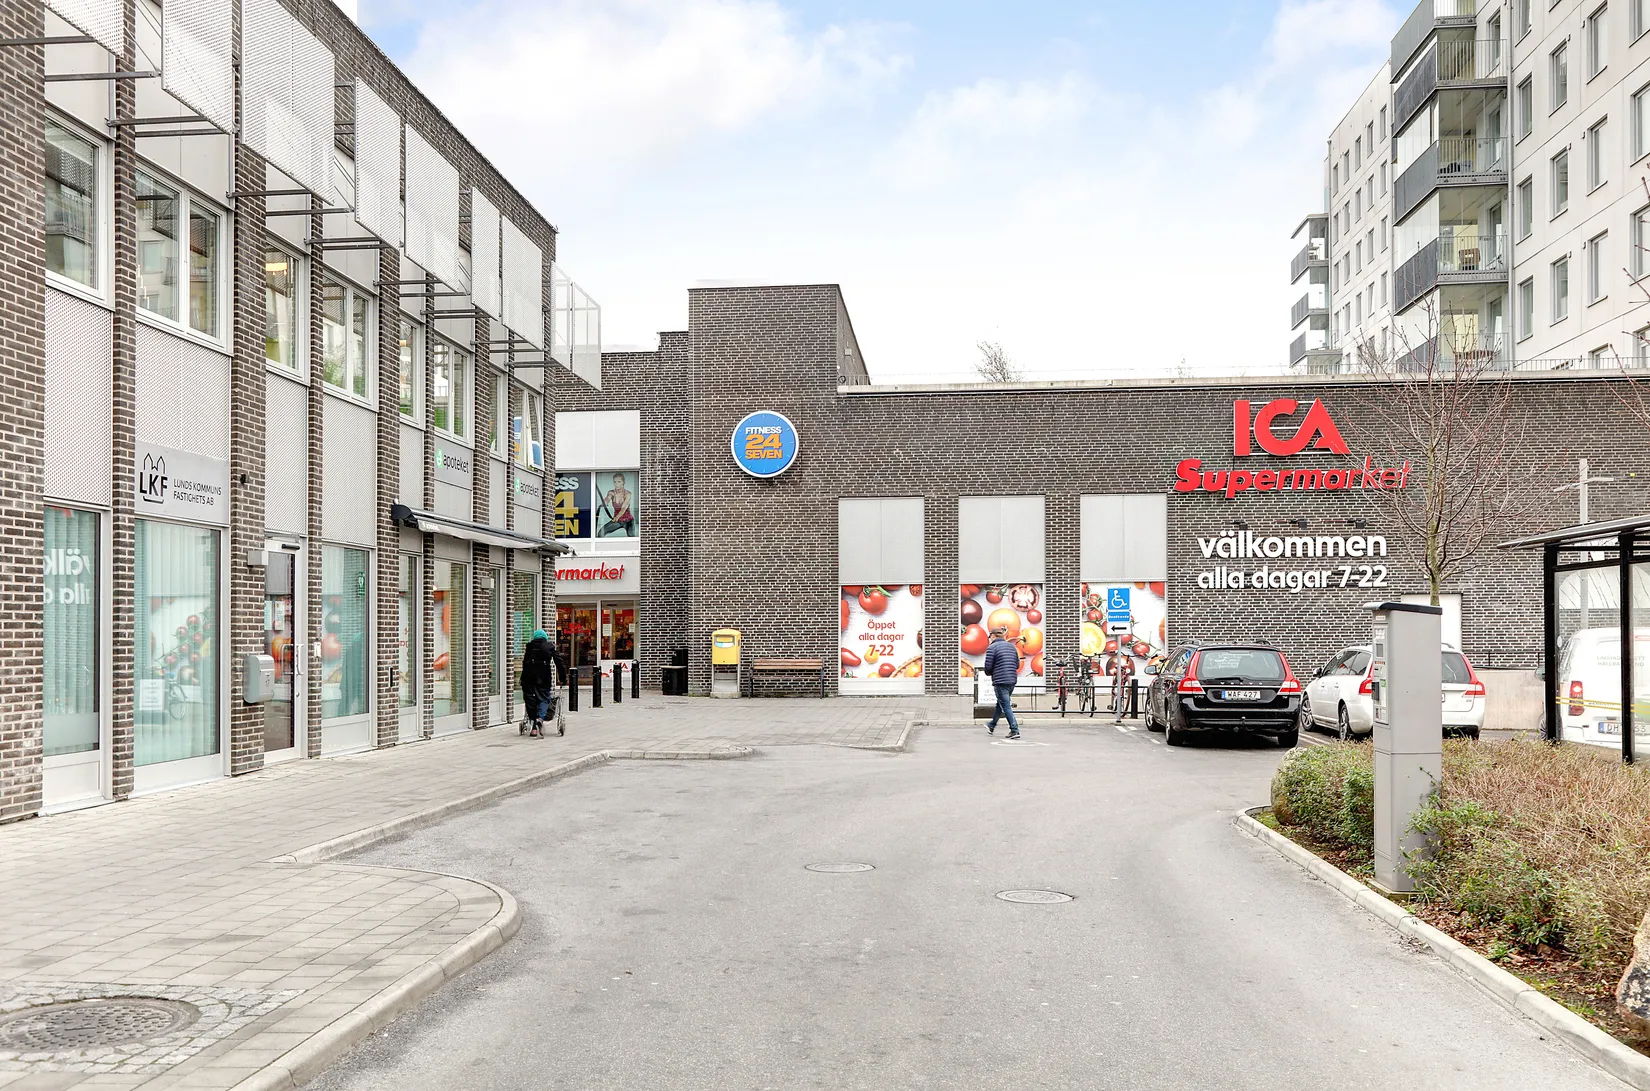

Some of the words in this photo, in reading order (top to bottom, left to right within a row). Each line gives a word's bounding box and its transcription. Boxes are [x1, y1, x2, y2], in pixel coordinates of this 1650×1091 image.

[745, 426, 782, 435] FITNESS
[1233, 397, 1351, 456] ICA
[745, 434, 782, 450] 24
[745, 449, 783, 460] SEVEN
[443, 454, 469, 474] apoteket
[139, 471, 168, 497] LKF
[1173, 455, 1412, 499] Supermarket
[173, 478, 193, 491] LUNDS
[193, 483, 222, 496] KOMMUNS
[173, 490, 206, 505] FASTIGHETS
[206, 496, 215, 506] AB
[1197, 530, 1387, 559] välkommen
[1197, 566, 1245, 589] alla
[1251, 565, 1332, 594] dagar
[1337, 564, 1388, 588] 7-22
[867, 619, 896, 631] Öppet
[858, 632, 876, 641] alla
[876, 632, 905, 643] dagar
[868, 644, 894, 656] 7-22
